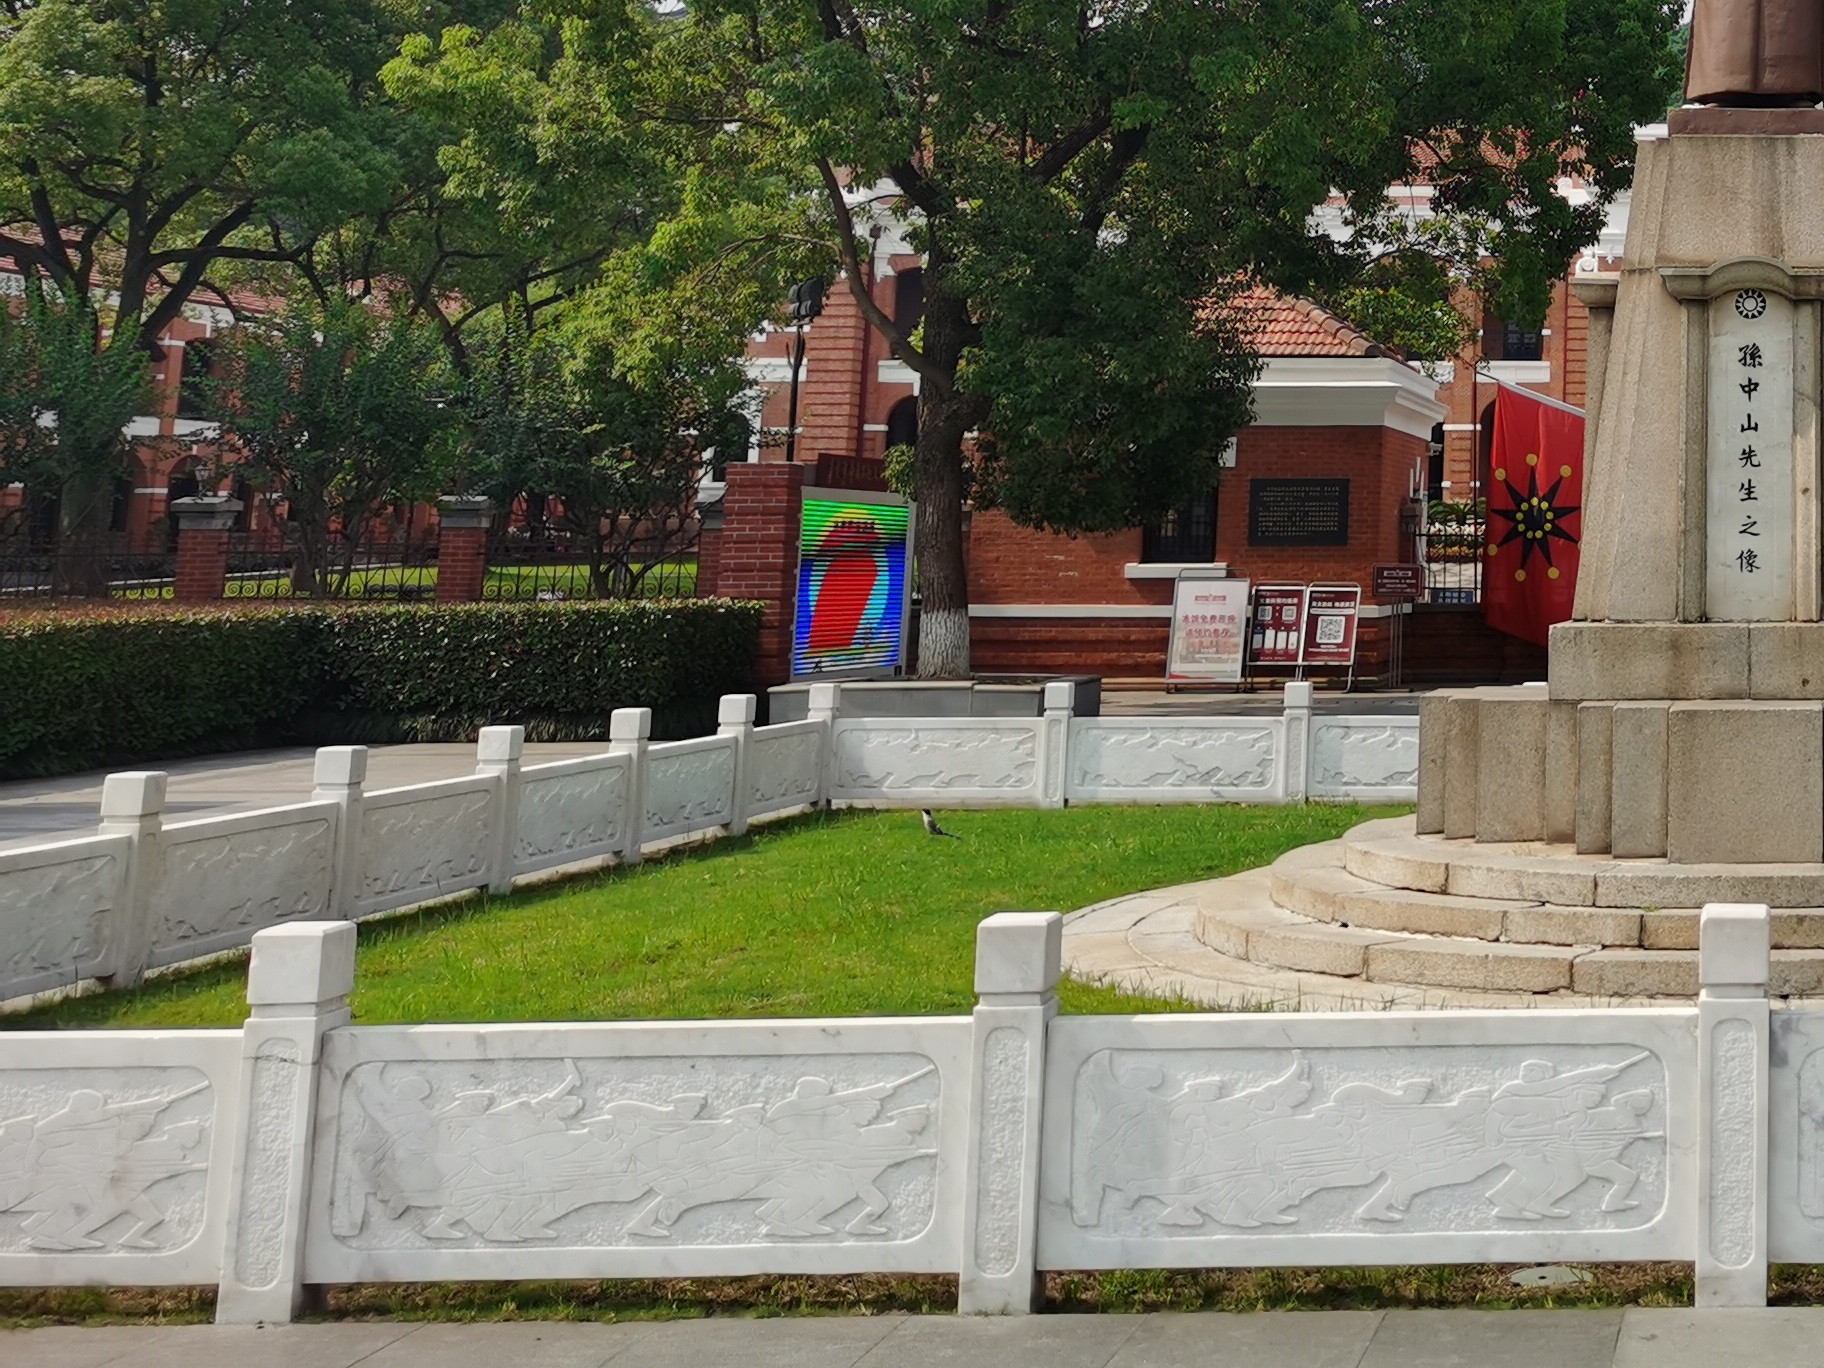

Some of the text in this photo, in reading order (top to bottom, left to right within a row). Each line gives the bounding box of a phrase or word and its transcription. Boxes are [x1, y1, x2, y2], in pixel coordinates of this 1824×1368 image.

[1736, 342, 1763, 573] 孫中山先生之像
